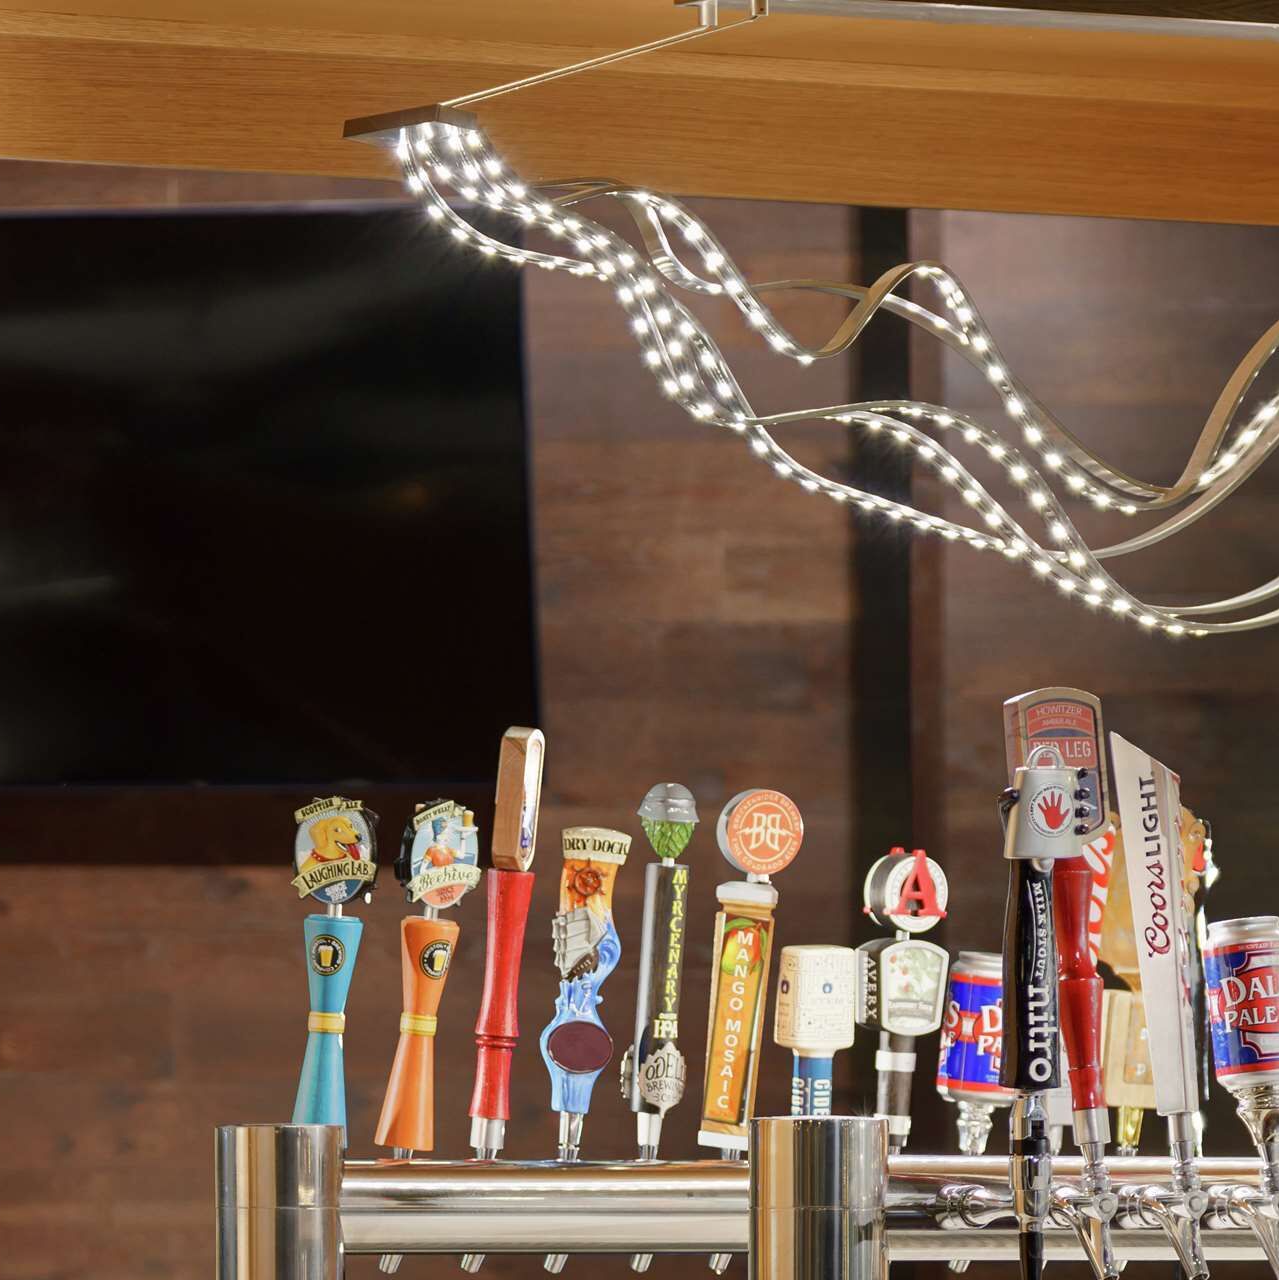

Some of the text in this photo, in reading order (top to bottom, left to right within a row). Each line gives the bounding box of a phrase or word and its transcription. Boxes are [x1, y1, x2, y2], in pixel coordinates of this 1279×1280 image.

[1065, 739, 1092, 759] LEG
[301, 799, 334, 818] SCOTTISH
[1138, 775, 1163, 858] LIGHT
[564, 836, 630, 856] DRY DOCK
[302, 860, 369, 890] LAUGHING LAB
[1144, 859, 1171, 958] Coors
[867, 957, 878, 1019] AVERY
[716, 930, 756, 1110] MANGO MOSAIC
[1027, 984, 1060, 1083] nitro
[1223, 1006, 1278, 1033] PALE
